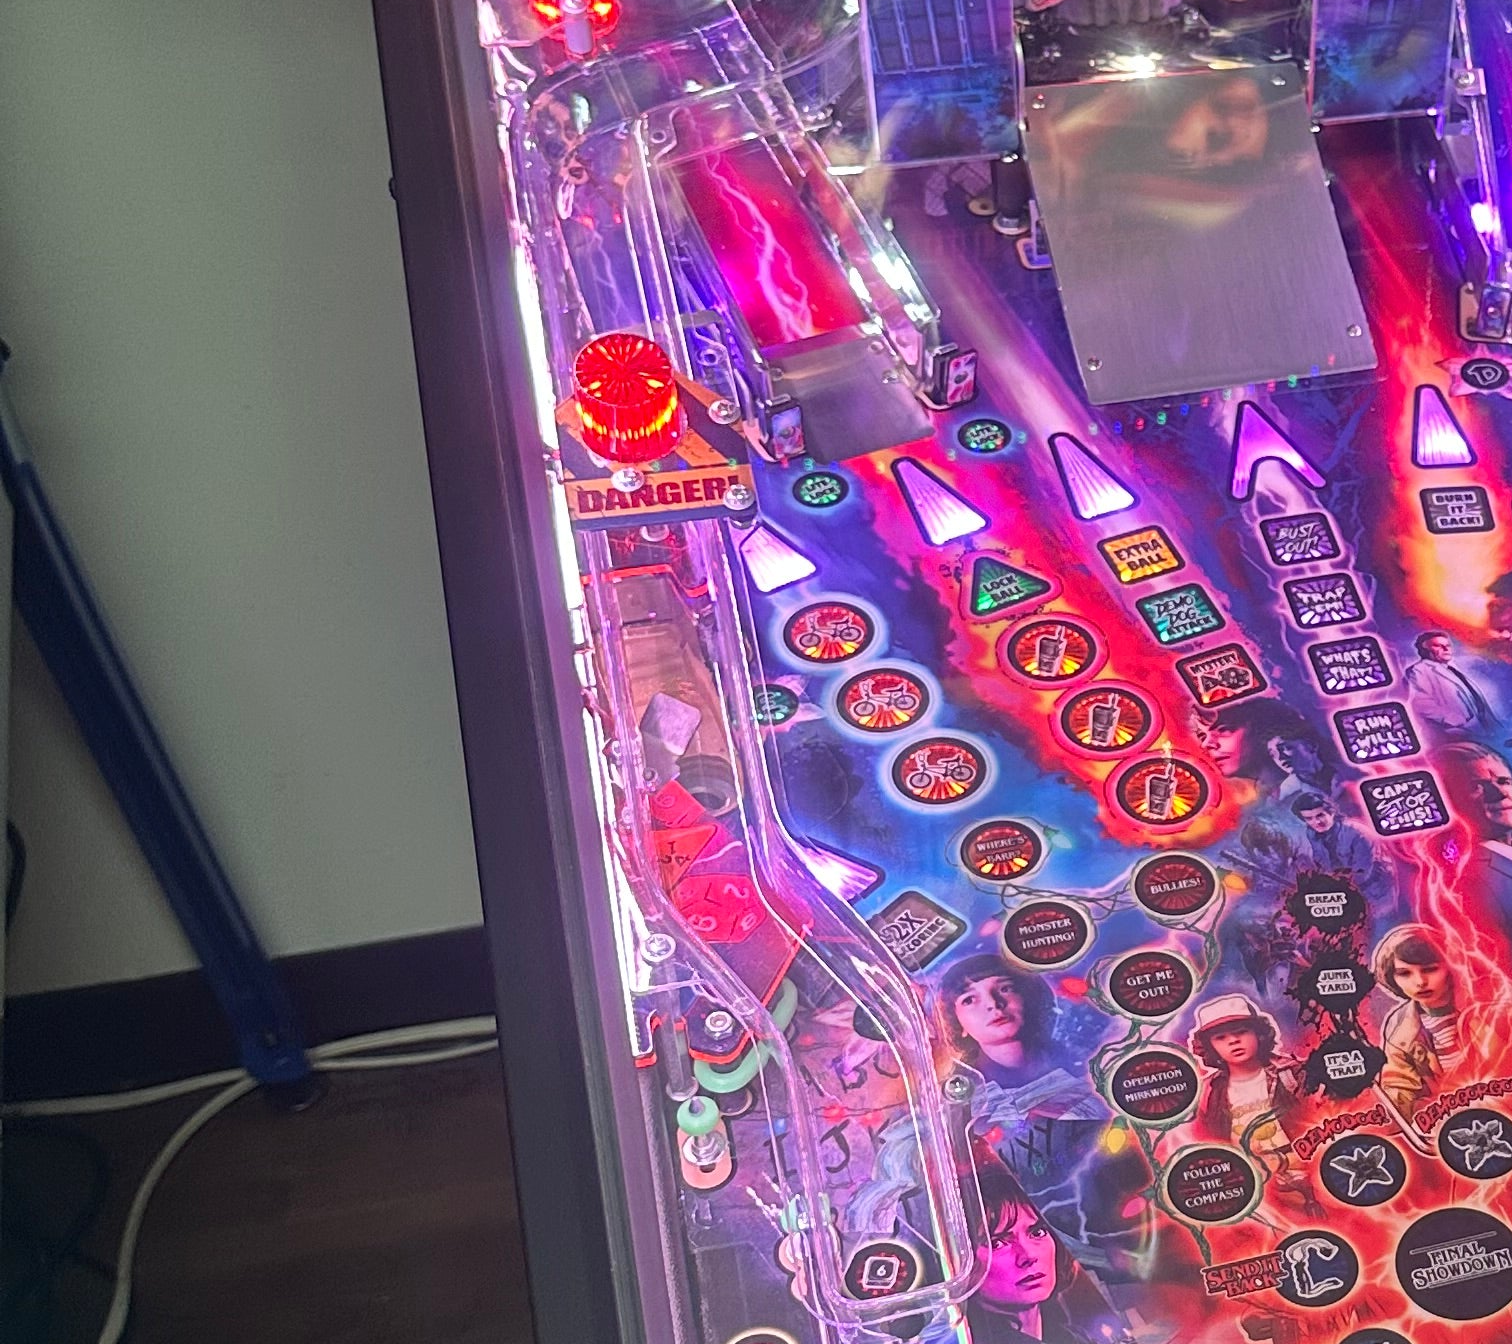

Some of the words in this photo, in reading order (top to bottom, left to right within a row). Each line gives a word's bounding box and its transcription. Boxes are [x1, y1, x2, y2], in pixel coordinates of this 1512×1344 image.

[1277, 522, 1320, 541] BUST
[1113, 539, 1163, 560] EXTRA
[1128, 554, 1167, 572] BALL
[982, 574, 1018, 593] LOCK
[991, 586, 1024, 603] BALL
[1297, 587, 1346, 605] TRAP
[1154, 595, 1195, 617] DEMO
[1166, 615, 1214, 636] ATTACK
[1168, 608, 1198, 625] DOG
[1189, 653, 1240, 675] MYSTERY
[1320, 648, 1371, 665] WHAT'S
[1354, 715, 1392, 735] RUN
[1371, 779, 1424, 799] CAN'T
[1375, 791, 1431, 813] STOP
[1388, 805, 1434, 826] THIS!
[1150, 877, 1202, 895] BULLIES!
[1307, 894, 1345, 905] BREAK
[1313, 905, 1342, 916] OUT!
[1018, 917, 1072, 936] MONSTER
[1021, 931, 1075, 950] HUNTING!
[1126, 973, 1153, 987] GET
[1156, 969, 1175, 983] ME
[1319, 982, 1354, 993] YARD!
[1138, 985, 1170, 1000] OUT!
[1326, 1054, 1350, 1066] IT'S
[1122, 1068, 1183, 1088] OPERATION
[1329, 1064, 1364, 1078] TRAP!
[1124, 1082, 1188, 1103] MIRKWOOD!
[1293, 1105, 1391, 1160] DEMODOG!
[1183, 1161, 1231, 1182] FOLLOW
[1199, 1177, 1223, 1191] THE
[1185, 1187, 1245, 1208] COMPASS!
[1428, 1241, 1486, 1265] FINAL
[1205, 1260, 1259, 1290] SEND
[1258, 1254, 1285, 1276] IT
[1226, 1273, 1281, 1297] BACK
